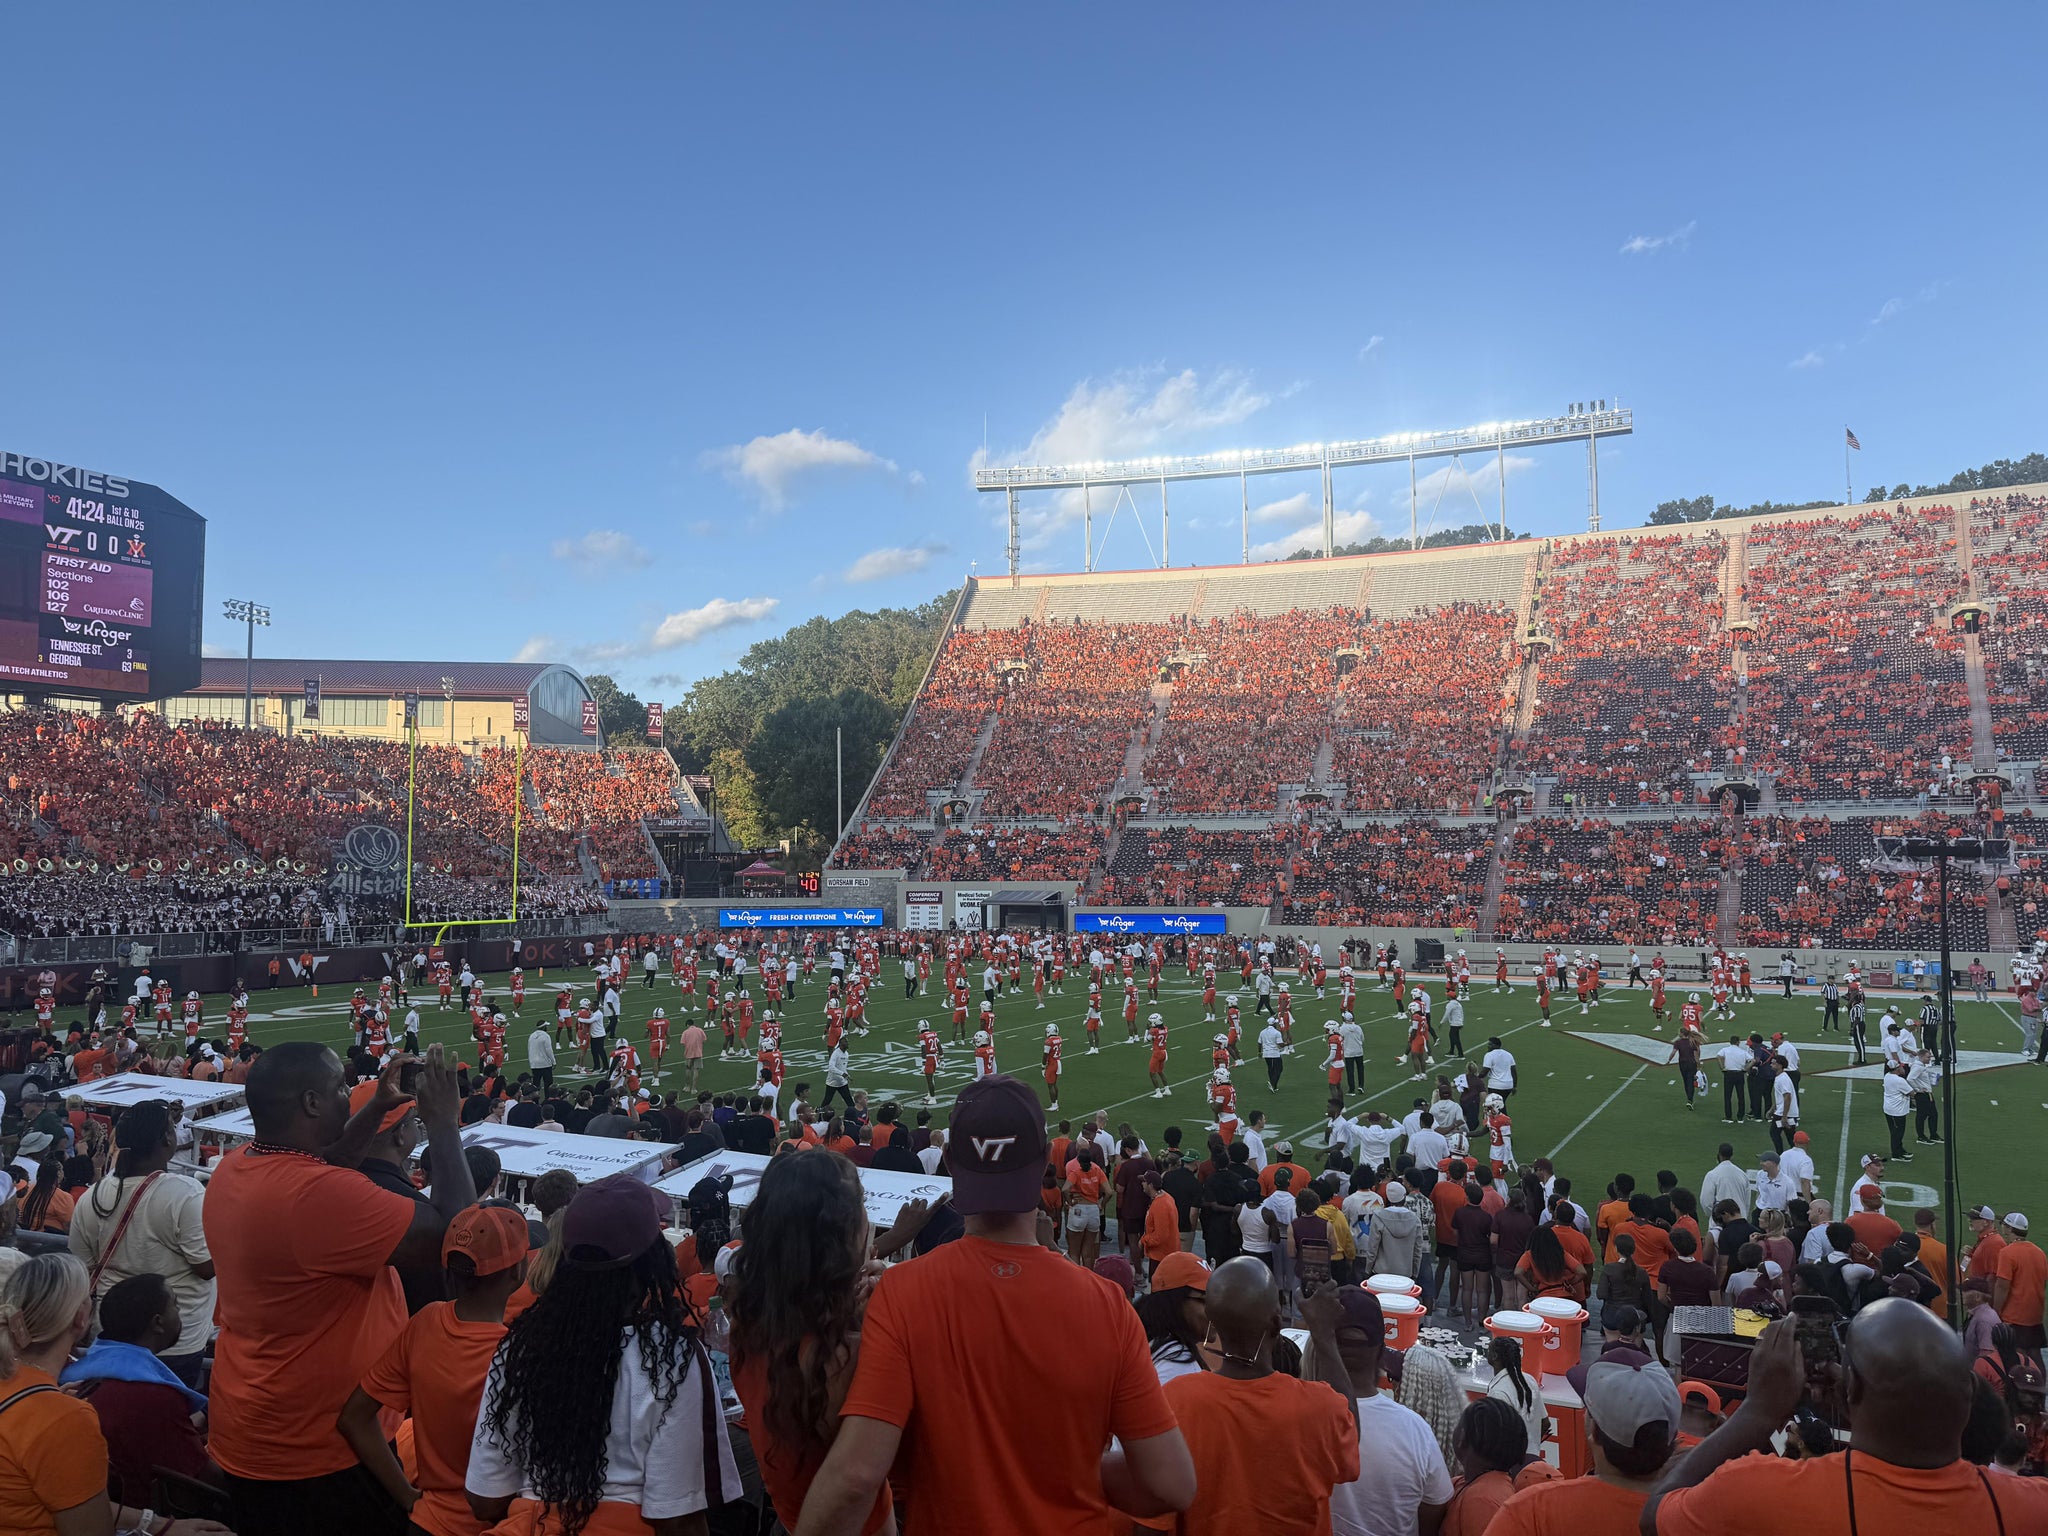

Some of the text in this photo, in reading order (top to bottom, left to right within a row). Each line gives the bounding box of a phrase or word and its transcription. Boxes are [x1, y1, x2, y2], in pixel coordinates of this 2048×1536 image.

[0, 452, 130, 498] HOKIES
[66, 497, 105, 523] 41:24
[112, 505, 121, 515] 1st
[131, 509, 139, 519] 10
[107, 515, 145, 530] BALL ON 25
[45, 524, 83, 544] VT
[87, 532, 97, 551] 0
[109, 536, 118, 555] 0
[48, 555, 112, 573] FIRST AID
[47, 568, 94, 584] Sections
[47, 579, 69, 590] 102
[46, 590, 70, 602] 106
[46, 602, 68, 612] 127
[84, 620, 132, 647] Kroger
[50, 639, 92, 654] TENNESSEE
[49, 653, 82, 667] GEORGIA
[127, 649, 133, 659] 3
[11, 666, 30, 675] TECH
[30, 669, 69, 679] ATHLETICS
[122, 662, 147, 673] 63 FINAL
[307, 696, 318, 707] 64
[515, 710, 528, 721] 58
[583, 713, 597, 725] 73
[649, 715, 662, 726] 78
[328, 872, 409, 895] Allstate
[801, 879, 818, 891] 40
[738, 911, 763, 925] Kroger
[853, 910, 876, 923] Kroger
[1110, 916, 1135, 931] Kroger
[1175, 916, 1200, 931] Kroger
[185, 1004, 196, 1012] 19
[1682, 1008, 1696, 1021] 95
[928, 1037, 939, 1051] 20
[775, 1057, 780, 1072] 2
[971, 1136, 1016, 1160] VT
